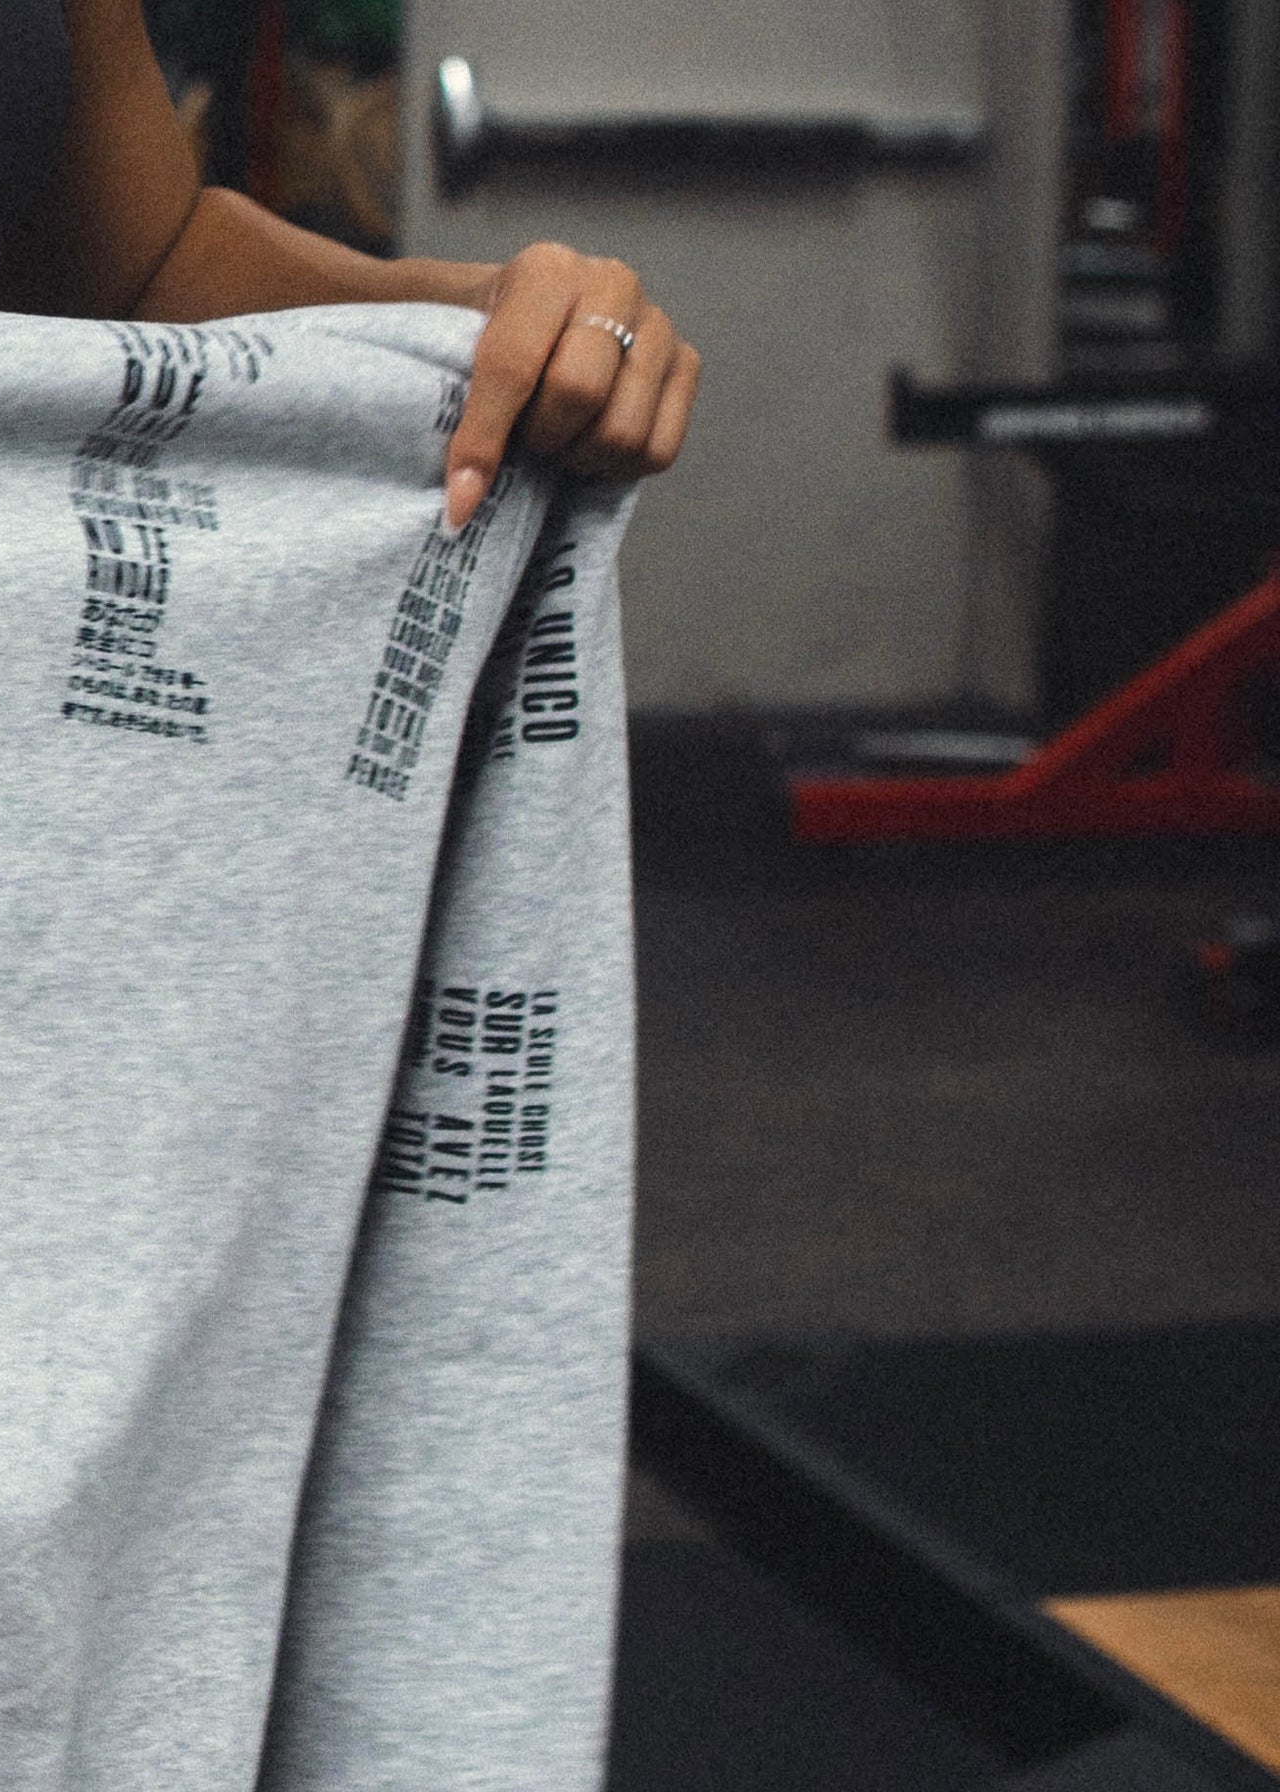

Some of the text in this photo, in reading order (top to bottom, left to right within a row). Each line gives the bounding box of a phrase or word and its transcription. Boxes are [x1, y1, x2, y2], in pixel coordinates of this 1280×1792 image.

[521, 610, 581, 744] UNICO
[480, 990, 528, 1056] SUR
[425, 987, 479, 1205] VOUS AVEZ
